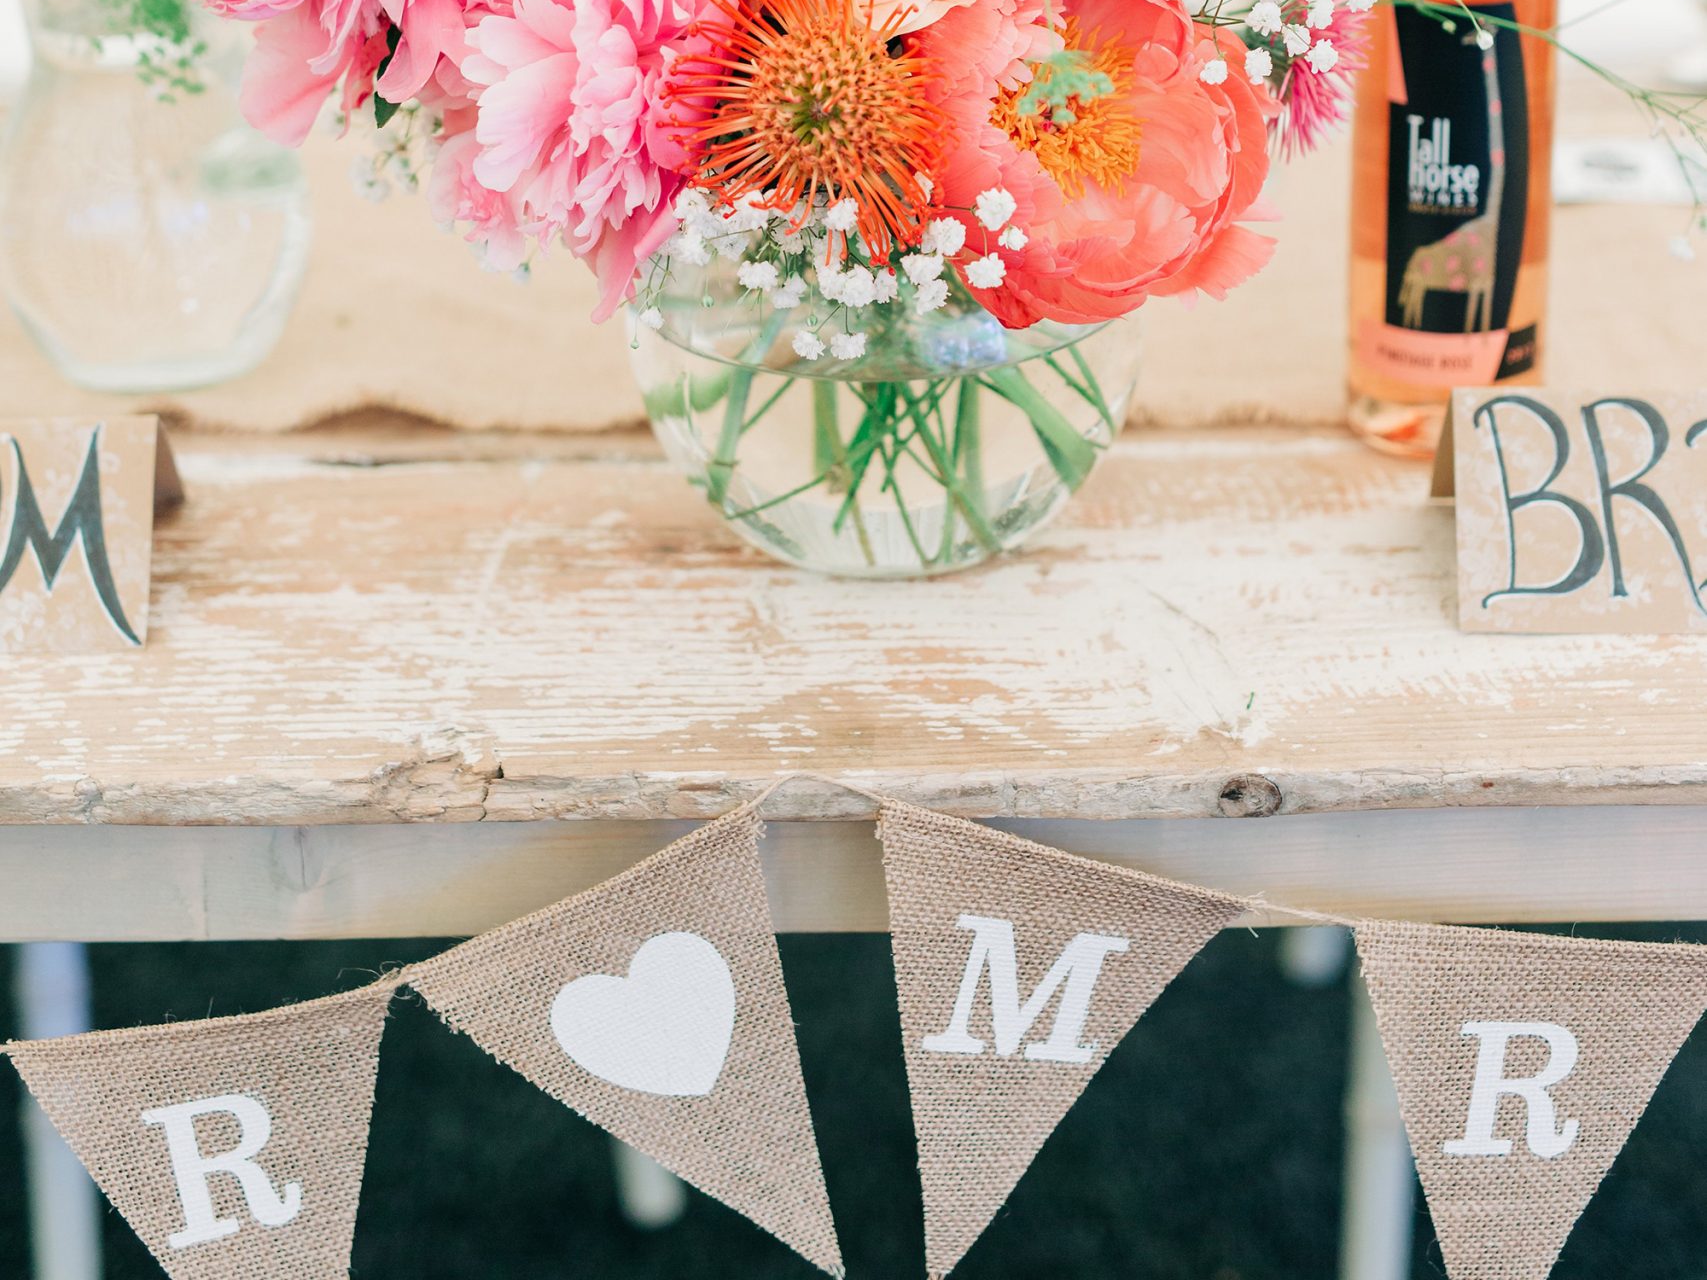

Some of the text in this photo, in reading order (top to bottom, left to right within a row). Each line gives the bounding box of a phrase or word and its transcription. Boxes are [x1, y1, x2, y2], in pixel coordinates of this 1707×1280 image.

[1406, 114, 1451, 164] Tall
[1408, 163, 1480, 193] horse
[0, 421, 143, 647] M
[142, 914, 1579, 1249] R M R
